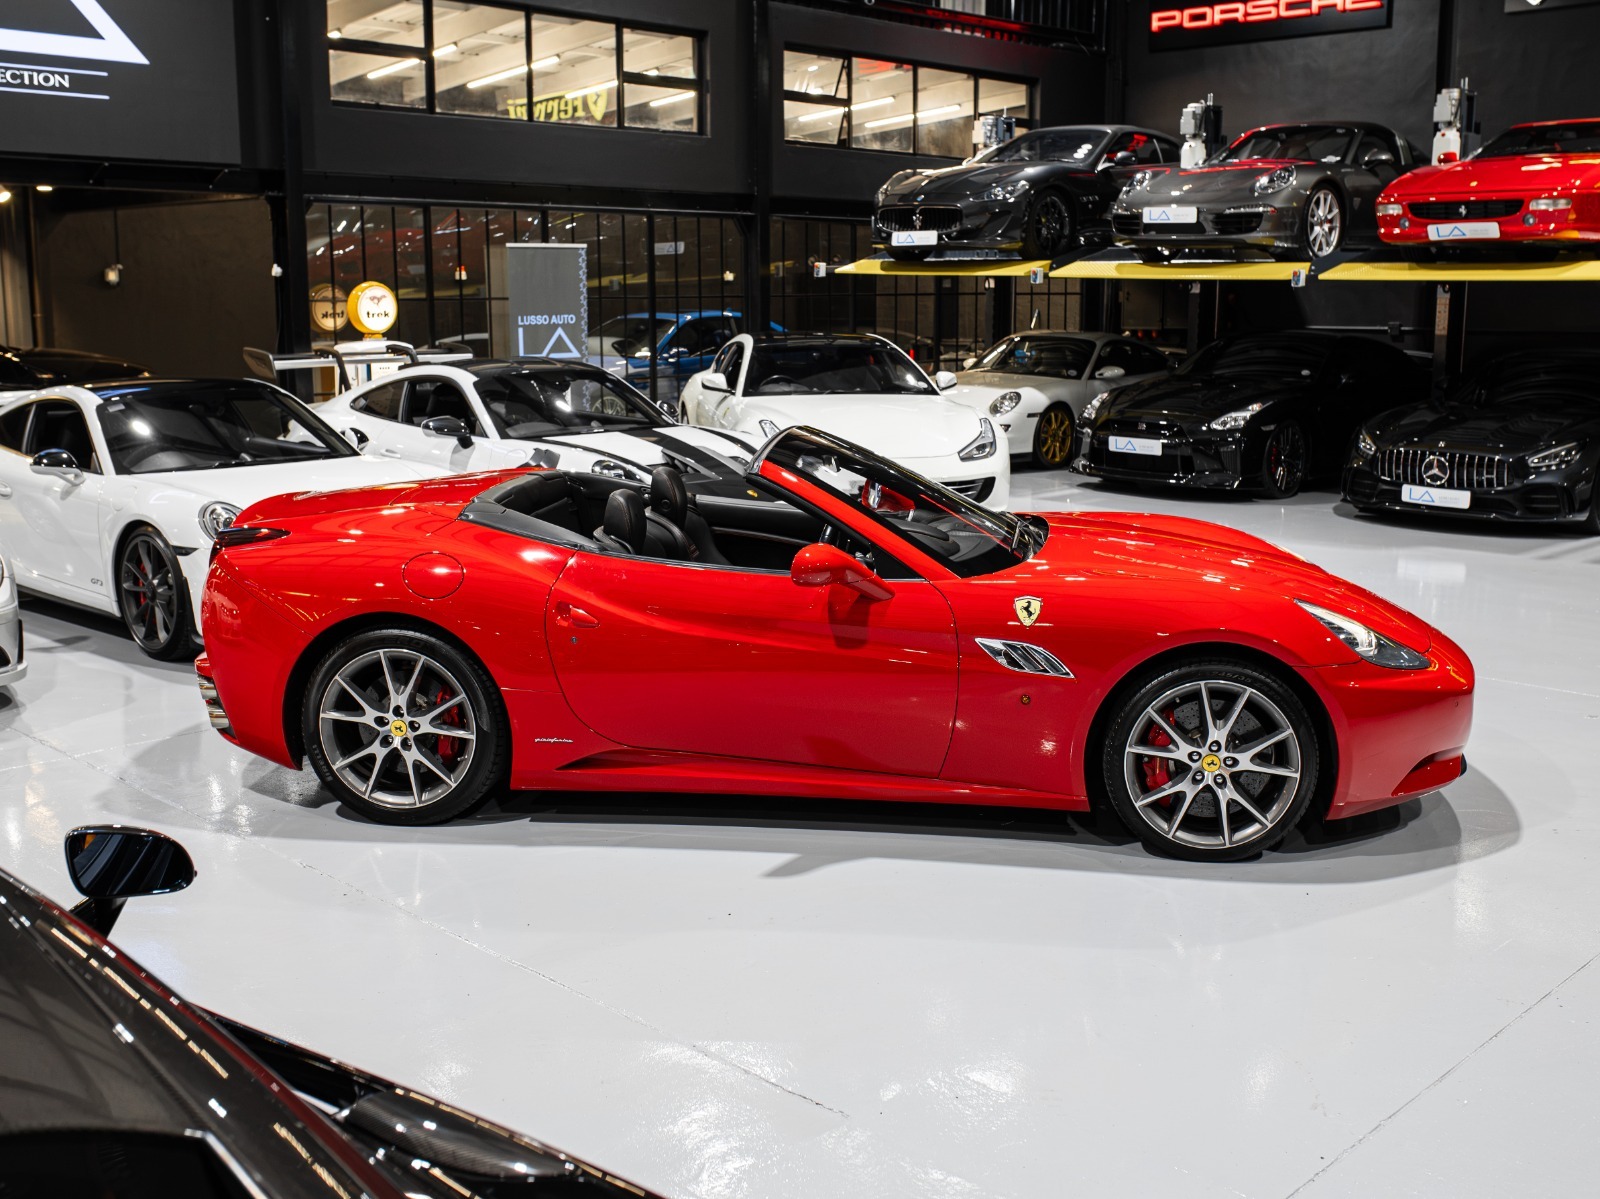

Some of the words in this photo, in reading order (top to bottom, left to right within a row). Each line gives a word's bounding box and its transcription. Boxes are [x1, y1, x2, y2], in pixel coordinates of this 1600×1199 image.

[366, 310, 390, 318] trek
[518, 315, 549, 325] LUSSO
[551, 314, 576, 325] AUTO
[518, 326, 582, 358] LA
